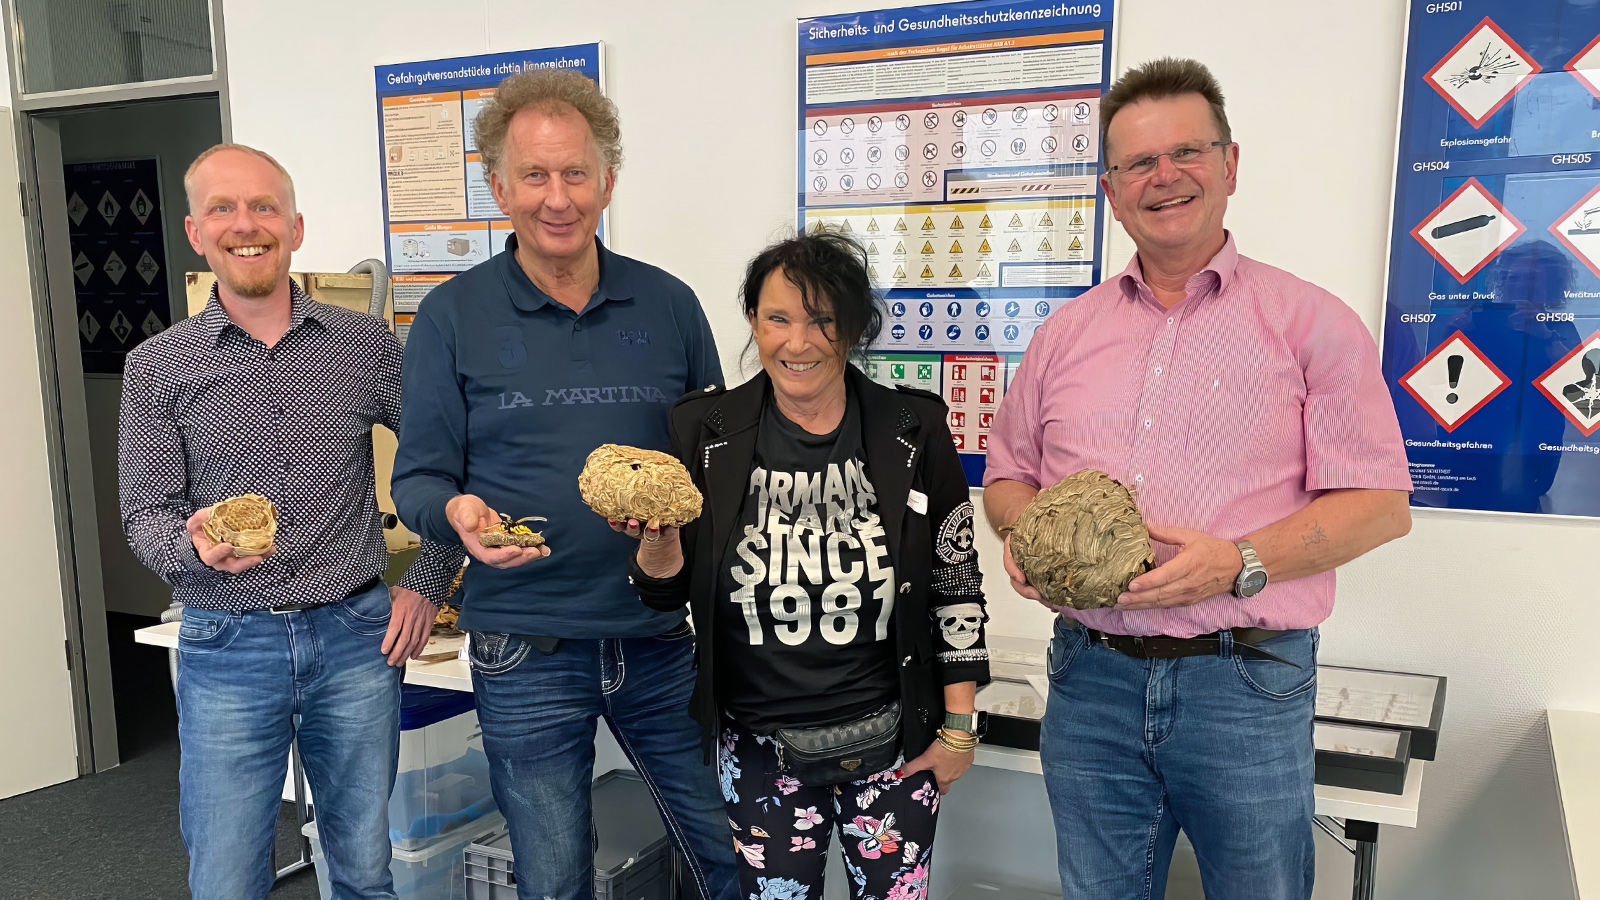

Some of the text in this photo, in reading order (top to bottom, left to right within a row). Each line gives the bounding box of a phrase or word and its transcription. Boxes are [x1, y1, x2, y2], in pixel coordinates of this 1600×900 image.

[1426, 1, 1463, 14] GHS01
[809, 3, 1101, 40] Sicherheits- und Gesundheitsschutzkennzeichnung
[387, 66, 491, 86] Gefahrgutversandstücke
[493, 62, 521, 76] richtig
[1440, 135, 1512, 149] Explosionsgefahr
[1552, 153, 1592, 165] GHS05
[1412, 160, 1450, 172] GHS04
[1428, 291, 1495, 300] Gas unter Druck
[1400, 313, 1437, 323] GHS07
[1536, 312, 1575, 322] GHS08
[498, 386, 668, 410] LA MARTINA
[1405, 439, 1493, 451] Gesundheitsgefahren
[744, 491, 880, 536] JEANS
[730, 526, 890, 587] SINCE
[730, 577, 895, 646] 1981
